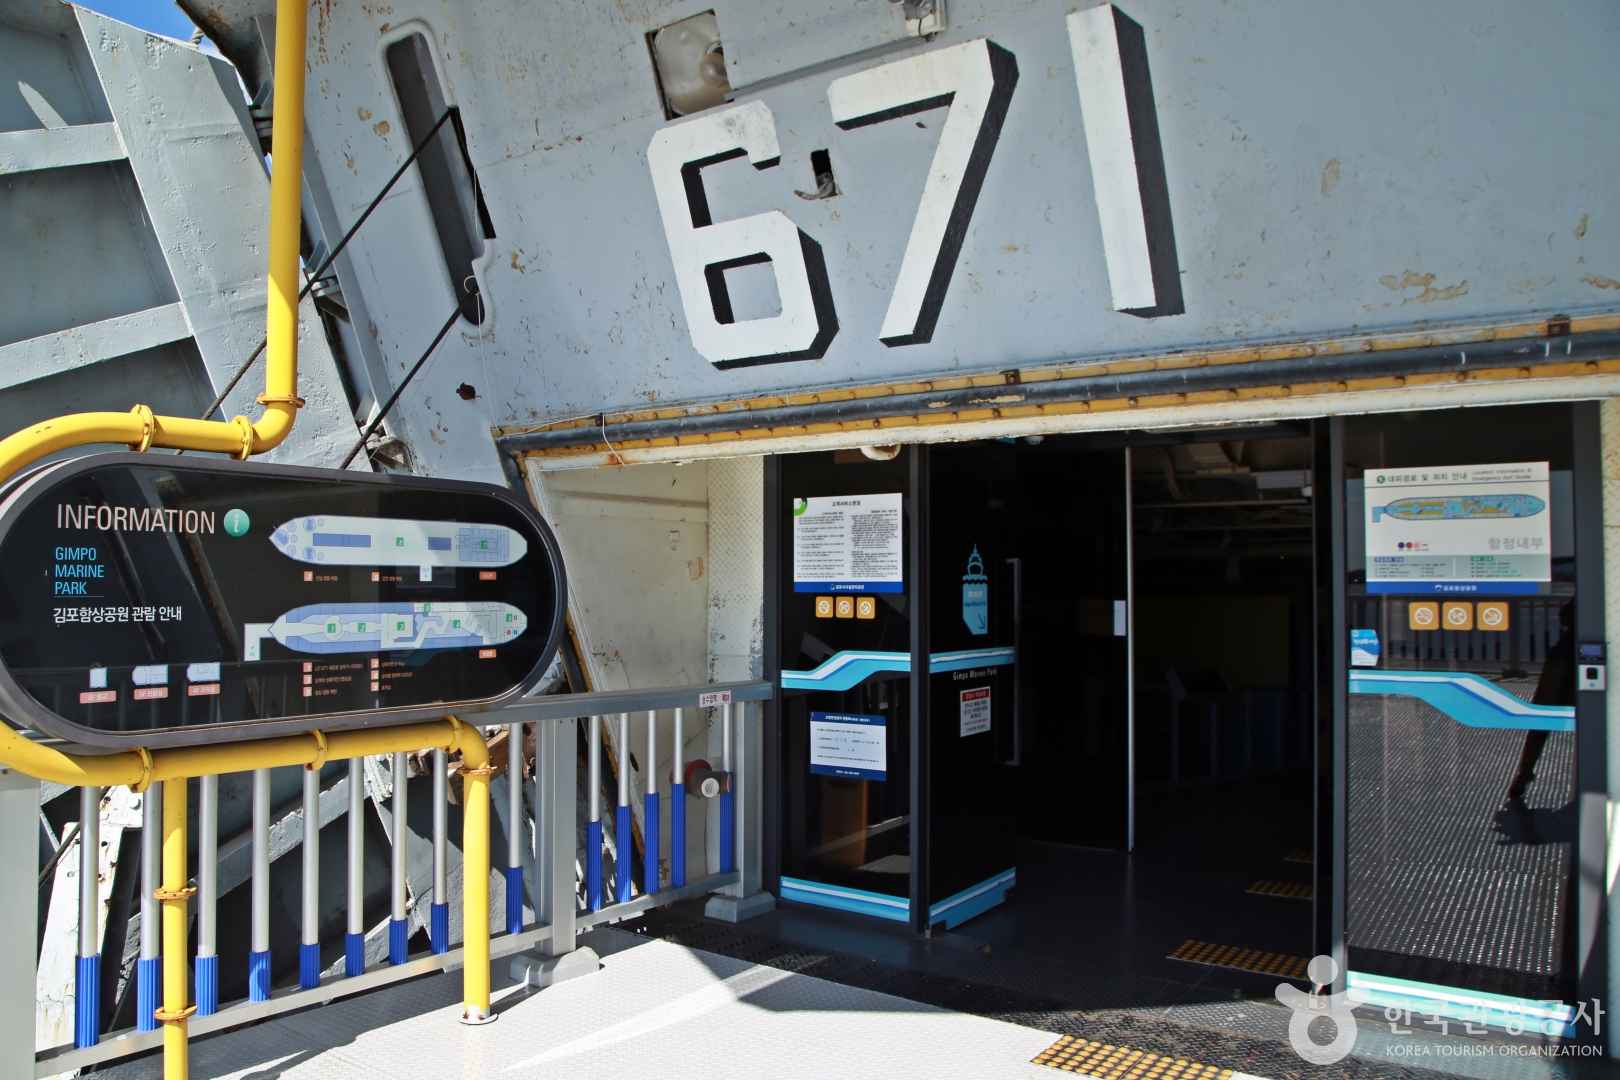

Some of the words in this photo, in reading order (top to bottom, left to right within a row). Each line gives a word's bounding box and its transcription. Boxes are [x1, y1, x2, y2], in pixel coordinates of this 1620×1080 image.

[647, 4, 1185, 370] 671
[57, 503, 216, 535] INFORMATION
[1488, 537, 1544, 551] 함정내부
[55, 546, 97, 561] GIMPO
[55, 564, 105, 578] MARINE
[55, 581, 88, 595] PARK
[53, 606, 129, 624] 김포함상공원
[132, 605, 157, 622] 관람
[159, 605, 182, 622] 안내
